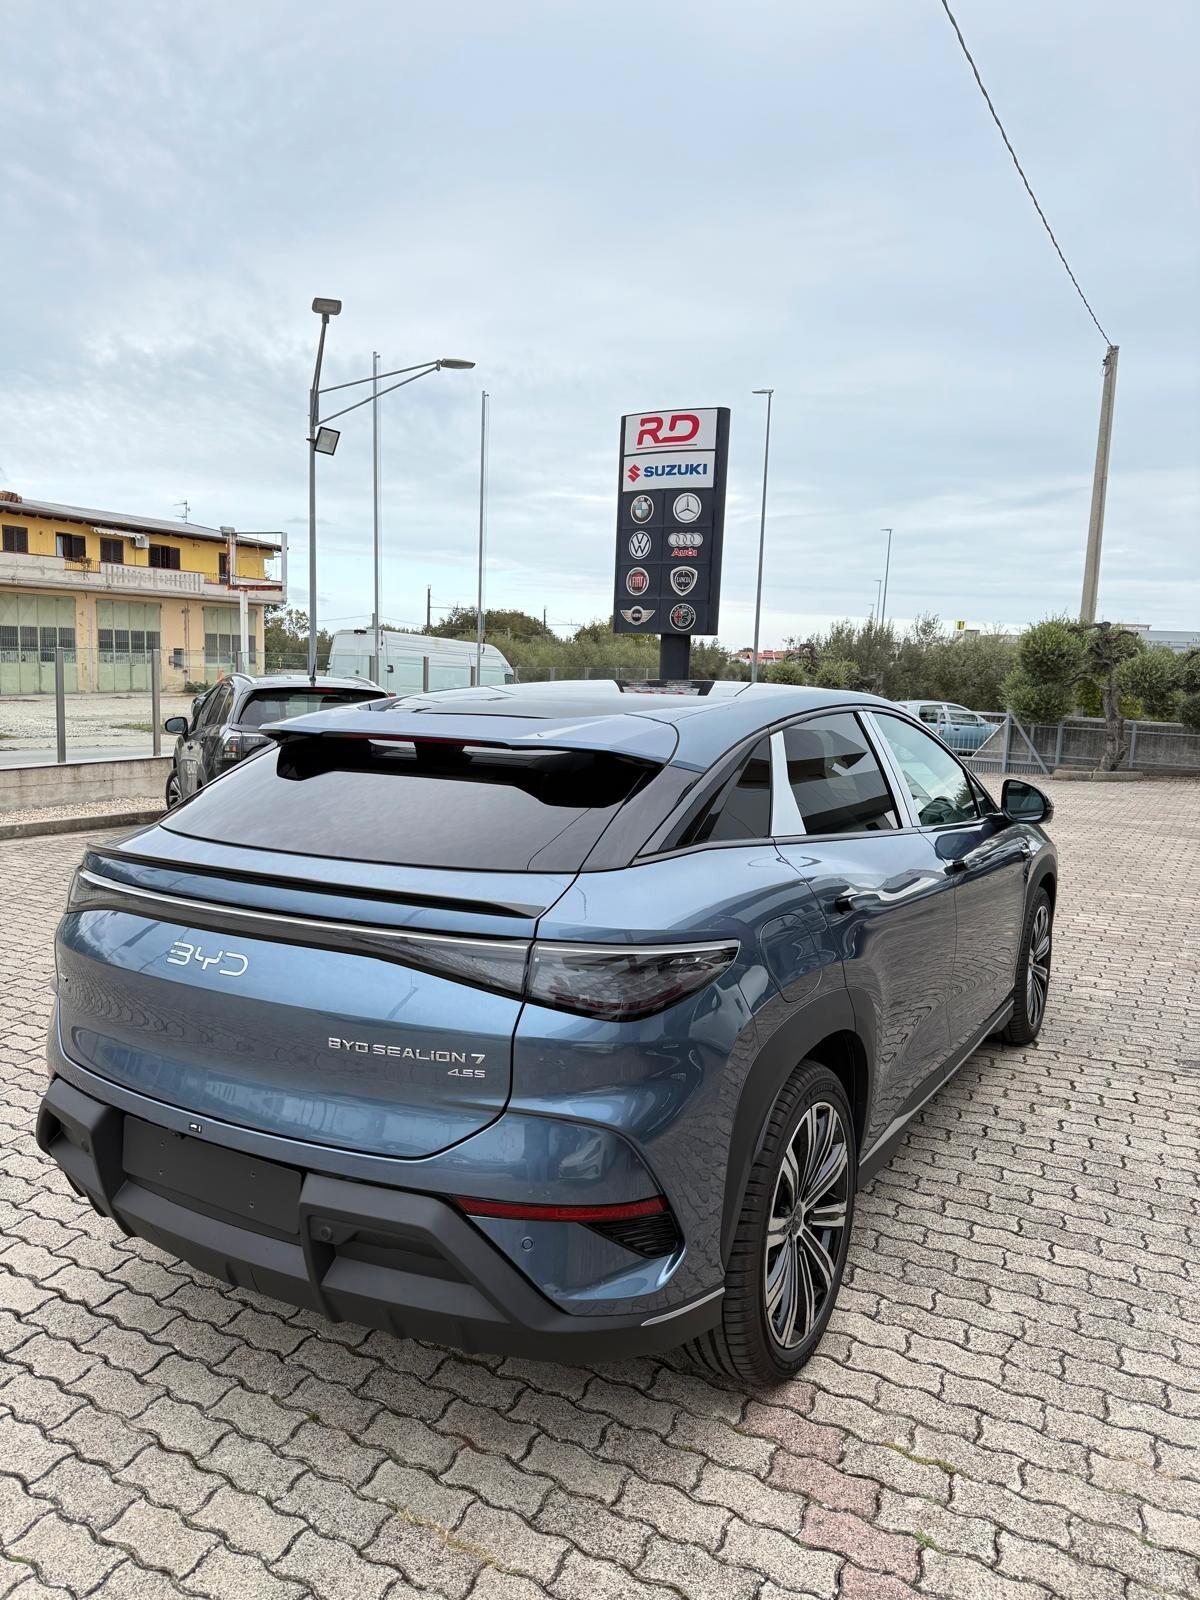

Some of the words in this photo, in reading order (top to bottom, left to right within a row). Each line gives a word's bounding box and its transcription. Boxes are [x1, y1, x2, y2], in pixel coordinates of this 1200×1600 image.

[637, 414, 700, 446] RD
[643, 463, 708, 478] SUZUKI
[671, 547, 698, 557] Audi
[166, 941, 249, 977] BYD
[328, 1037, 369, 1054] BYD
[372, 1044, 466, 1063] SEALION
[470, 1053, 486, 1065] 7
